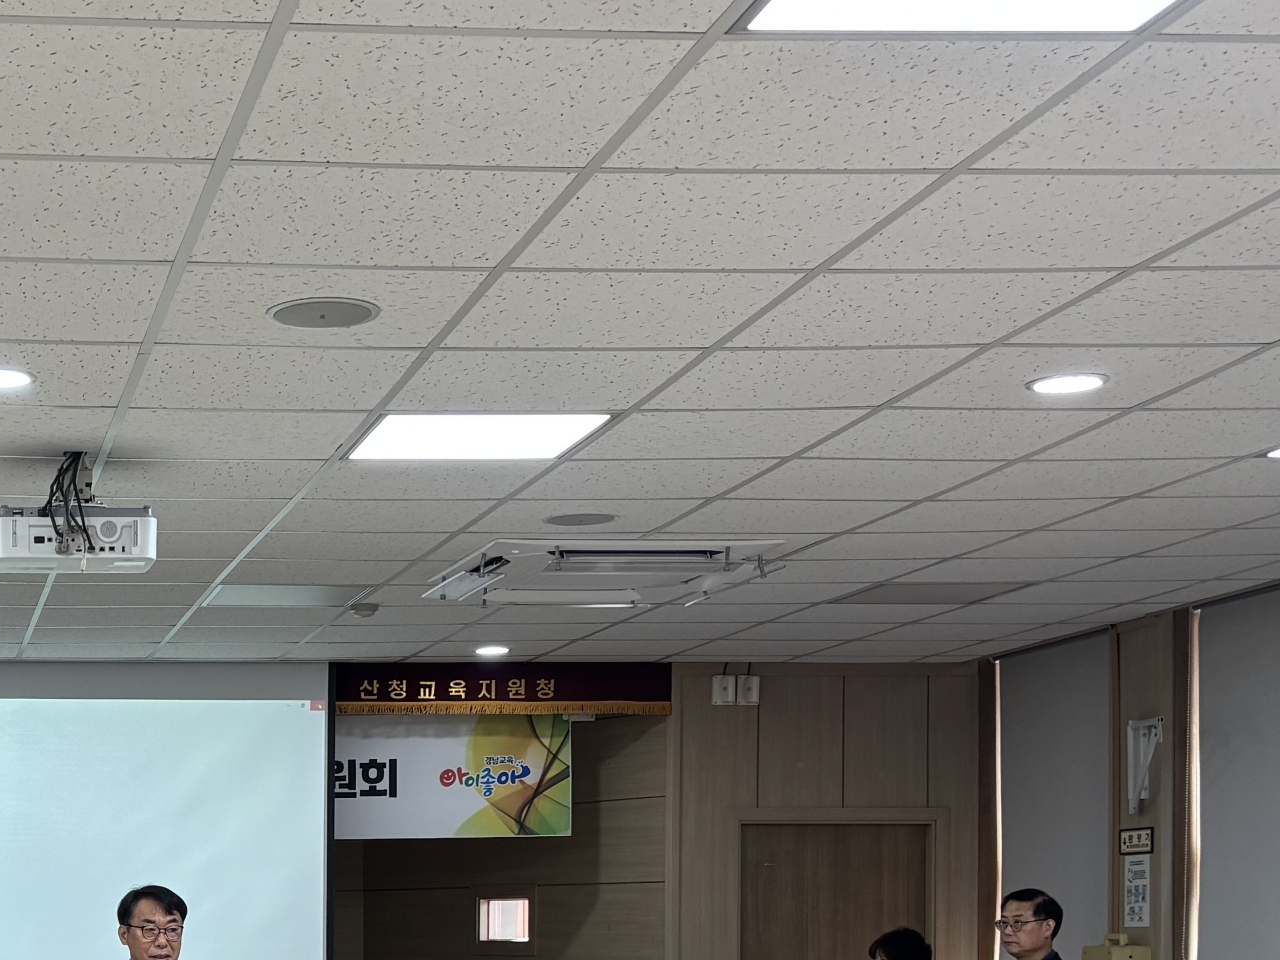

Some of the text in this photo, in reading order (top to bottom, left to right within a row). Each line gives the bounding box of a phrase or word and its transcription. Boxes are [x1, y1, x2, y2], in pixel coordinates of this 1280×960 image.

[359, 678, 556, 700] 산청교육지원청
[484, 756, 514, 765] 경남교육
[439, 764, 531, 797] 아이좋아
